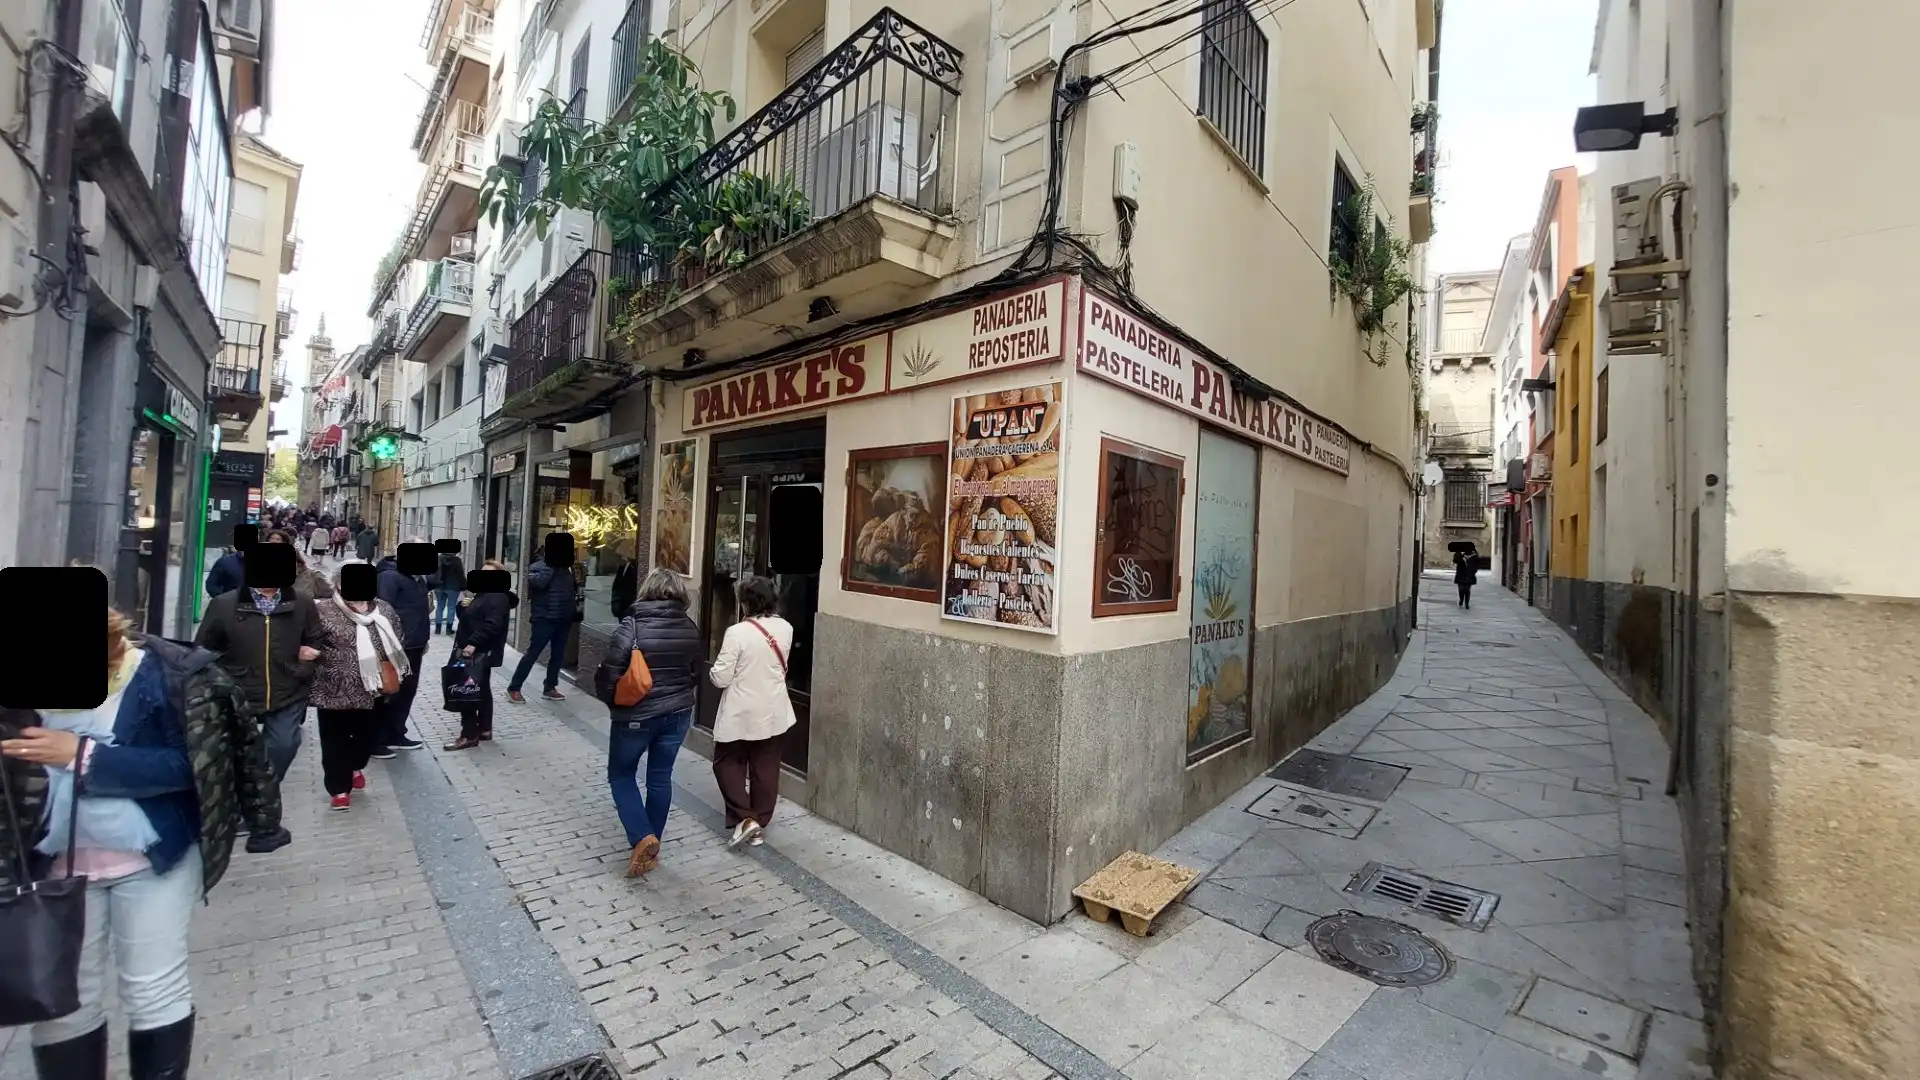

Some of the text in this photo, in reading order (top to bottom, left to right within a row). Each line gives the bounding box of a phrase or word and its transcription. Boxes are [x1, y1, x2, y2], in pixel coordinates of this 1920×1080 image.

[973, 291, 1047, 336] PANADERIA
[969, 327, 1050, 369] REPOSTERIA
[1091, 301, 1182, 370] PANADERIA
[692, 344, 865, 425] PANAKE'S
[1086, 340, 1184, 404] PASTELERIA
[1191, 359, 1313, 455] PANAKE'S
[973, 406, 1045, 438] UPAN
[1316, 424, 1349, 451] PANADERIA
[1314, 446, 1349, 471] PASTELERIA
[972, 514, 1028, 531] Pan de Pueblo
[1002, 540, 1039, 558] Calientes
[955, 564, 979, 580] Dulces
[981, 565, 1010, 582] Caseros
[1017, 568, 1044, 585] Tartas
[1000, 593, 1033, 613] Pasteles
[1194, 619, 1244, 645] PANAKE'S
